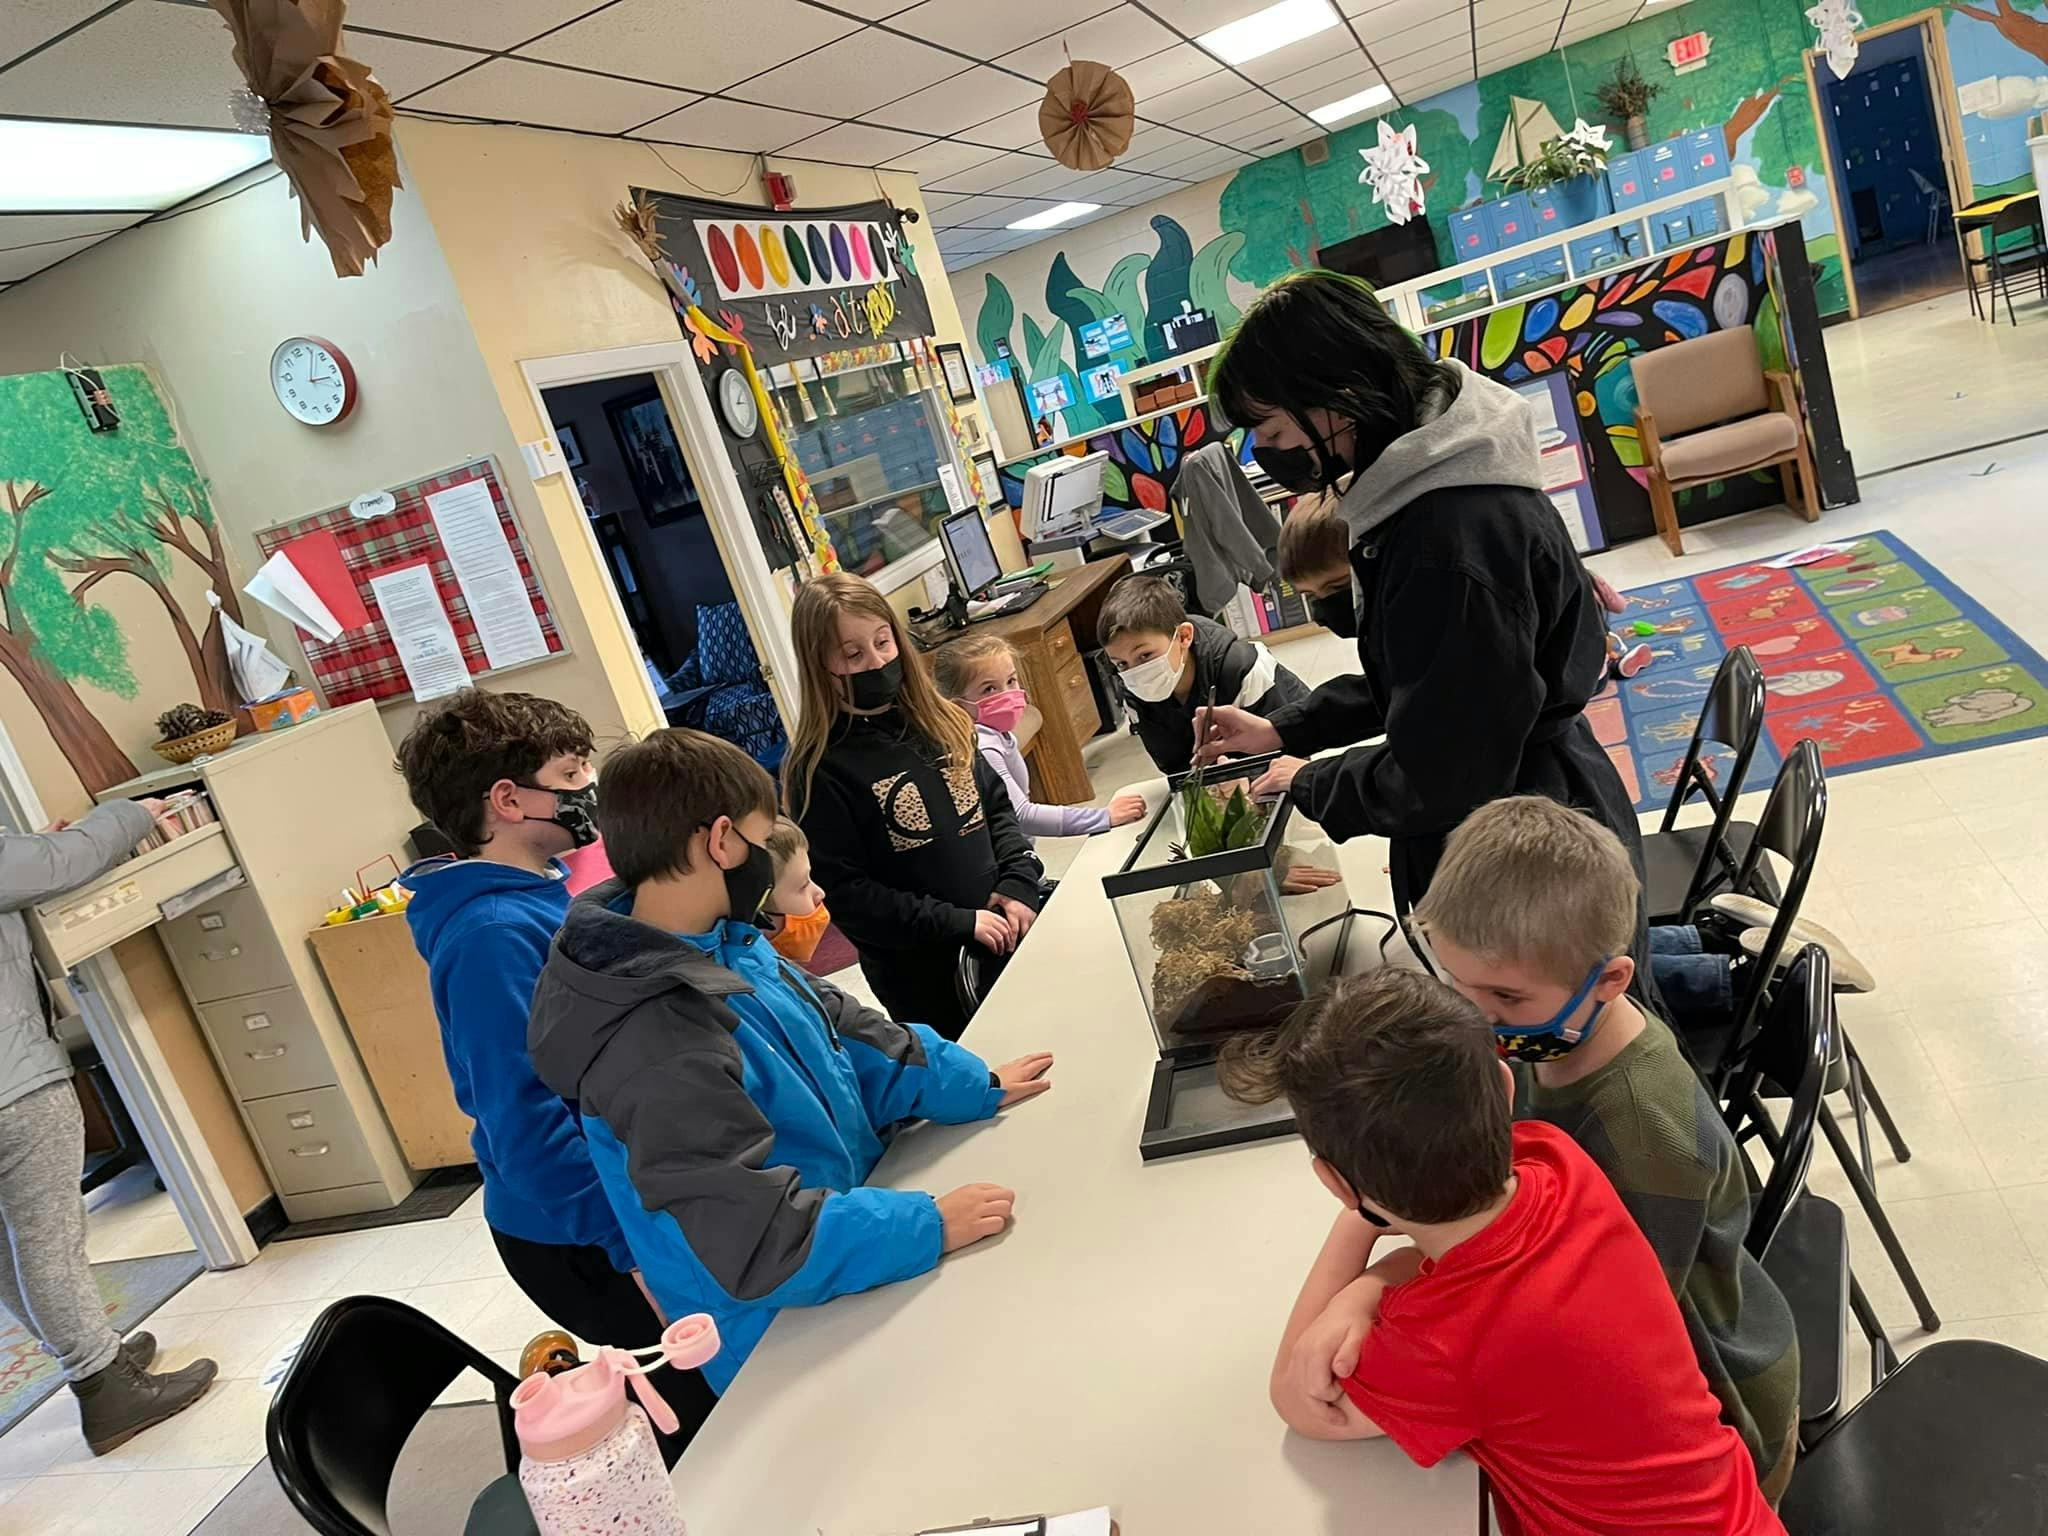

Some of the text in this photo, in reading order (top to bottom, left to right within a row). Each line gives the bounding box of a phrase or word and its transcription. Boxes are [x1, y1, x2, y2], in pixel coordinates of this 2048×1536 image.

[318, 351, 327, 362] 2
[328, 364, 337, 375] 3
[288, 388, 297, 399] 9
[332, 394, 340, 404] 5
[298, 400, 308, 411] 8
[324, 403, 333, 413] 6
[1934, 621, 1973, 639] Dd
[1980, 666, 2014, 684] Ee
[1844, 699, 1886, 715] Jj
